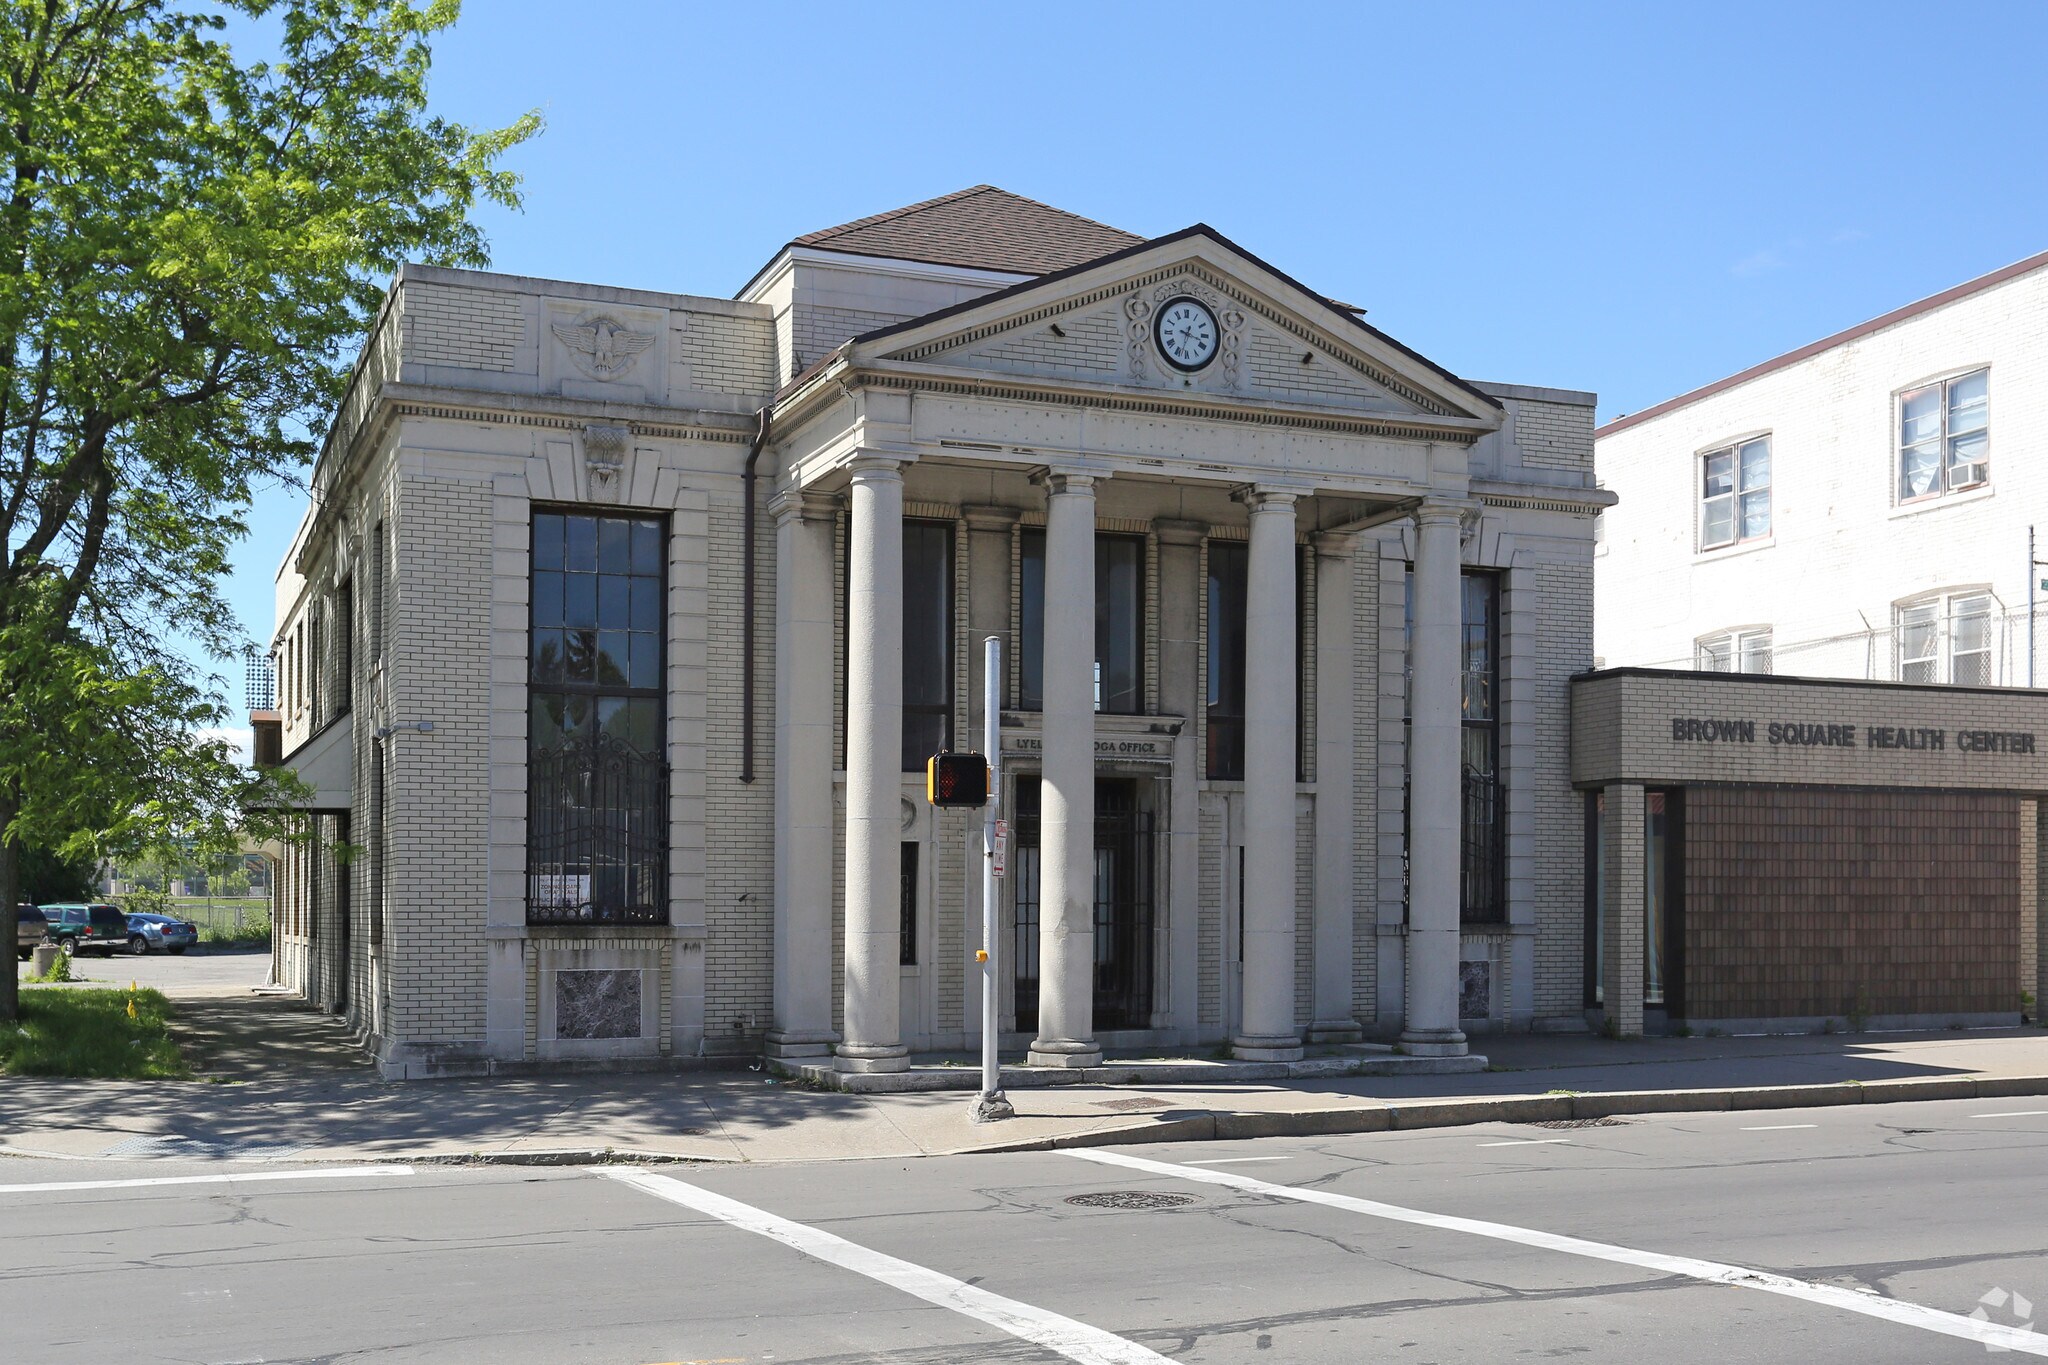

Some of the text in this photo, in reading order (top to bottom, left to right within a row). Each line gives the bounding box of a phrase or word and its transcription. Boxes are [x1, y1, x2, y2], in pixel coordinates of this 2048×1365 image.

[1017, 738, 1156, 753] LYEL OGA OFFICE
[1672, 718, 2036, 754] BROWN SQUARE HEALTH CENTER
